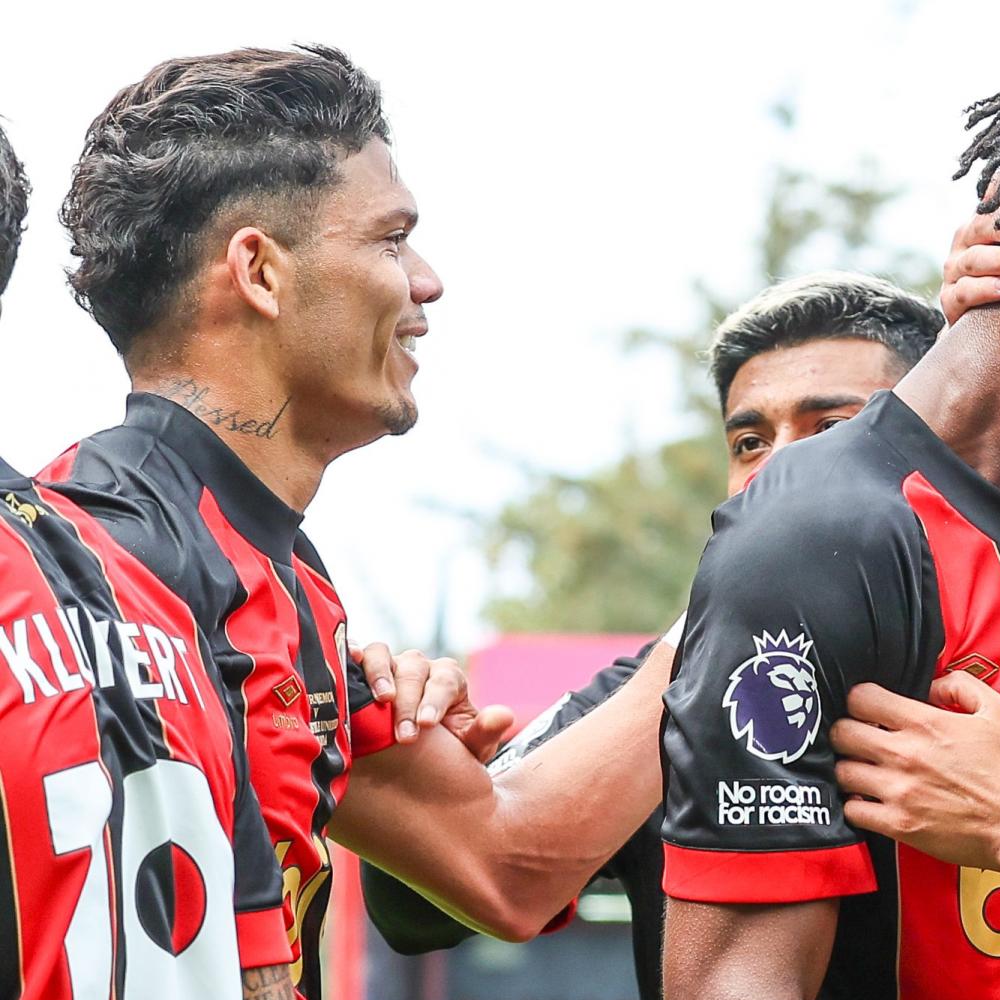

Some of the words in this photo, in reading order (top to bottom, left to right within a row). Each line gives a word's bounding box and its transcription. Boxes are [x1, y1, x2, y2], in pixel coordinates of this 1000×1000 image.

[718, 781, 756, 804] No
[760, 785, 821, 805] room
[718, 802, 755, 825] for
[759, 804, 831, 825] racism
